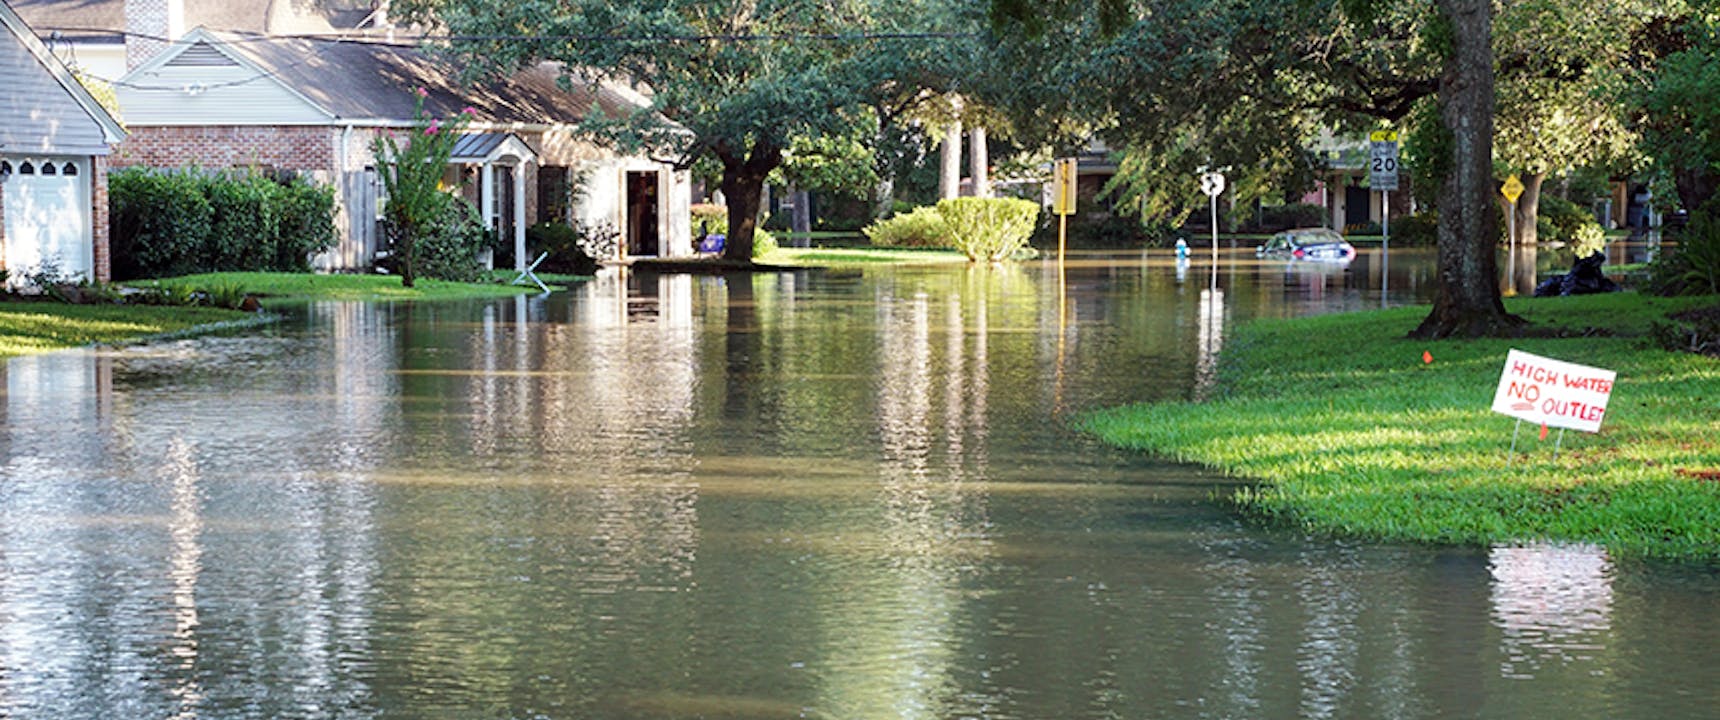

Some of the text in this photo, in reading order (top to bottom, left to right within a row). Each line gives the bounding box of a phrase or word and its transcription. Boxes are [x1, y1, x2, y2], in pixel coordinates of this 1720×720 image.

[1373, 158, 1395, 172] 20
[1511, 360, 1613, 394] HIGH WATER
[1507, 380, 1605, 422] NO OUTLET
